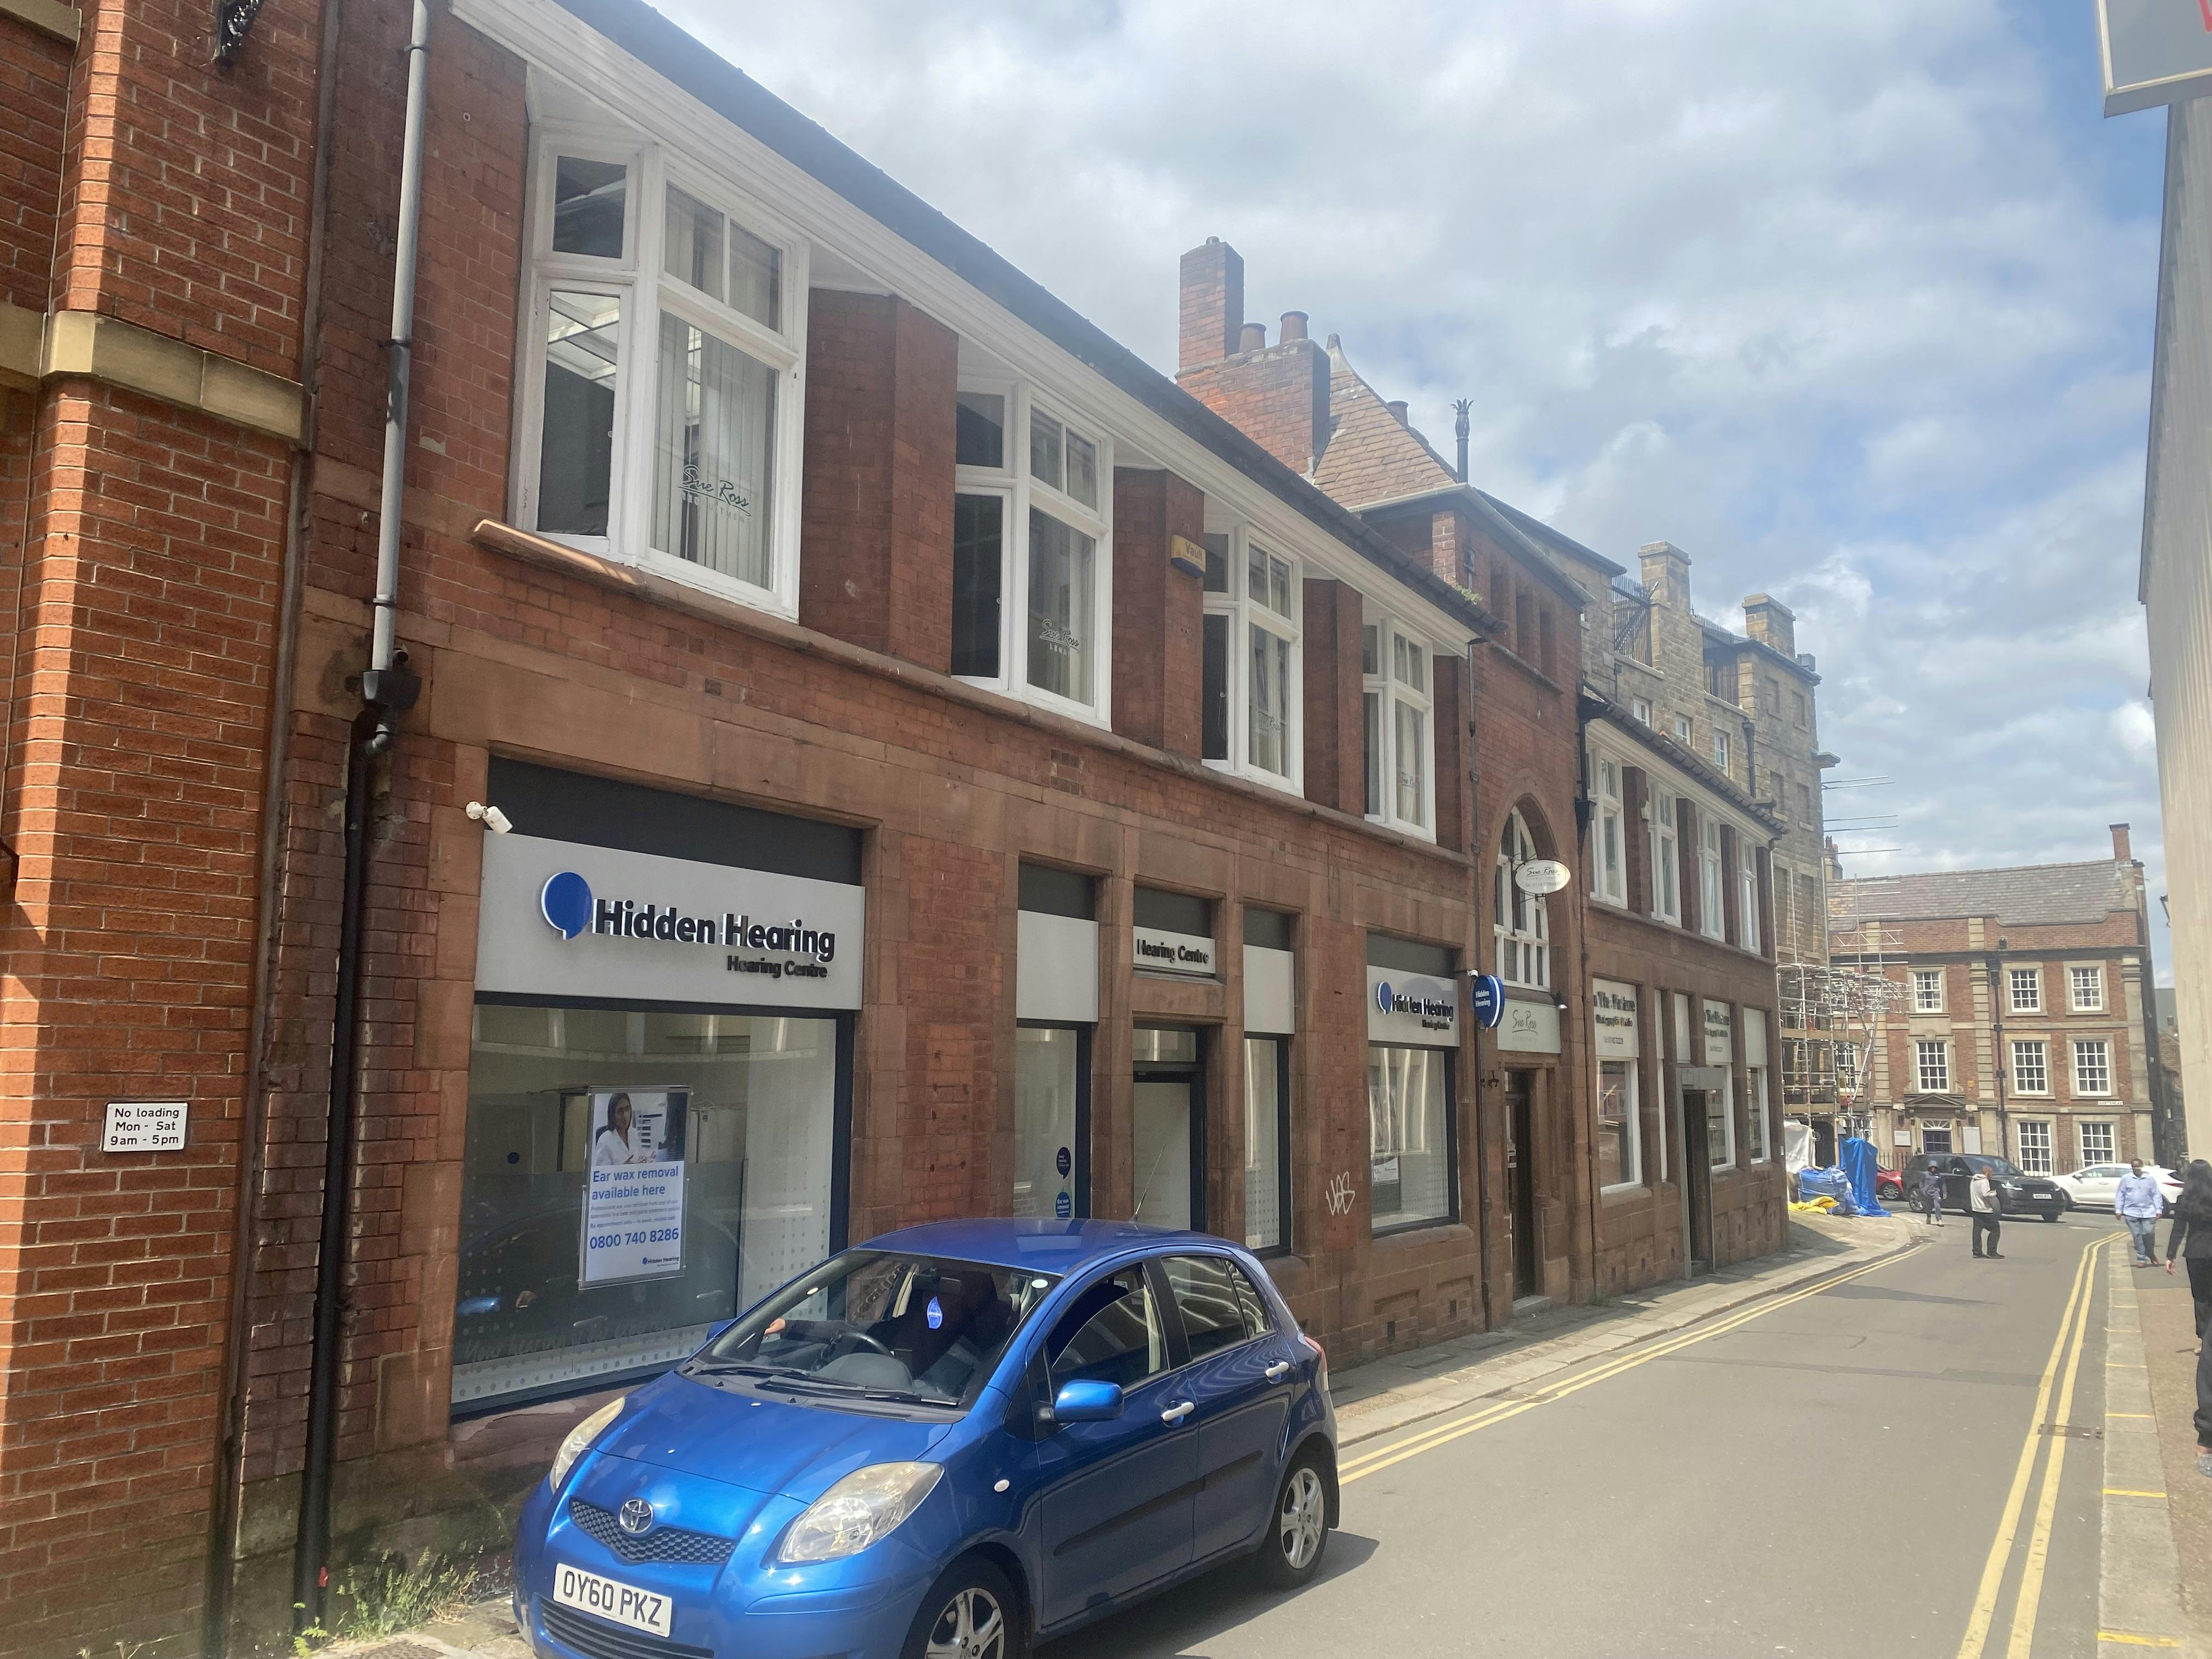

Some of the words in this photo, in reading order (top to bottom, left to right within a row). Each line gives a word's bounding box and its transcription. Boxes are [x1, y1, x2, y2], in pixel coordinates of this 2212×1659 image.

[682, 465, 714, 492] Sue
[719, 479, 749, 506] Ross
[1186, 541, 1203, 561] Vault
[1042, 618, 1060, 639] Sue
[1062, 627, 1080, 647] Ross
[1527, 867, 1541, 876] Sue
[1544, 866, 1559, 876] Ross
[592, 899, 715, 945] Hidden
[722, 913, 835, 962] Hearing
[1137, 939, 1176, 963] Hearing
[1178, 945, 1210, 964] Centre
[726, 955, 782, 978] Hearing
[785, 960, 828, 978] Centre
[1475, 990, 1489, 998] Hidden
[1475, 998, 1491, 1007] Hearing
[1391, 994, 1422, 1014] Hidden
[1423, 998, 1454, 1022] Hearing
[1512, 1009, 1524, 1029] Sue
[115, 1108, 131, 1118] No
[137, 1108, 179, 1119] loading
[116, 1122, 140, 1131] Mon
[156, 1121, 176, 1130] Sat
[111, 1136, 137, 1146] 9am
[152, 1135, 179, 1146] 5pm
[593, 1171, 610, 1182] Ear
[614, 1171, 635, 1181] wax
[637, 1165, 679, 1179] removal
[592, 1186, 639, 1200] available
[642, 1185, 665, 1196] here
[590, 1234, 621, 1249] 0800
[625, 1232, 646, 1245] 740
[650, 1228, 679, 1242] 8286
[563, 1570, 614, 1612] OY60
[619, 1588, 662, 1627] PKZ
